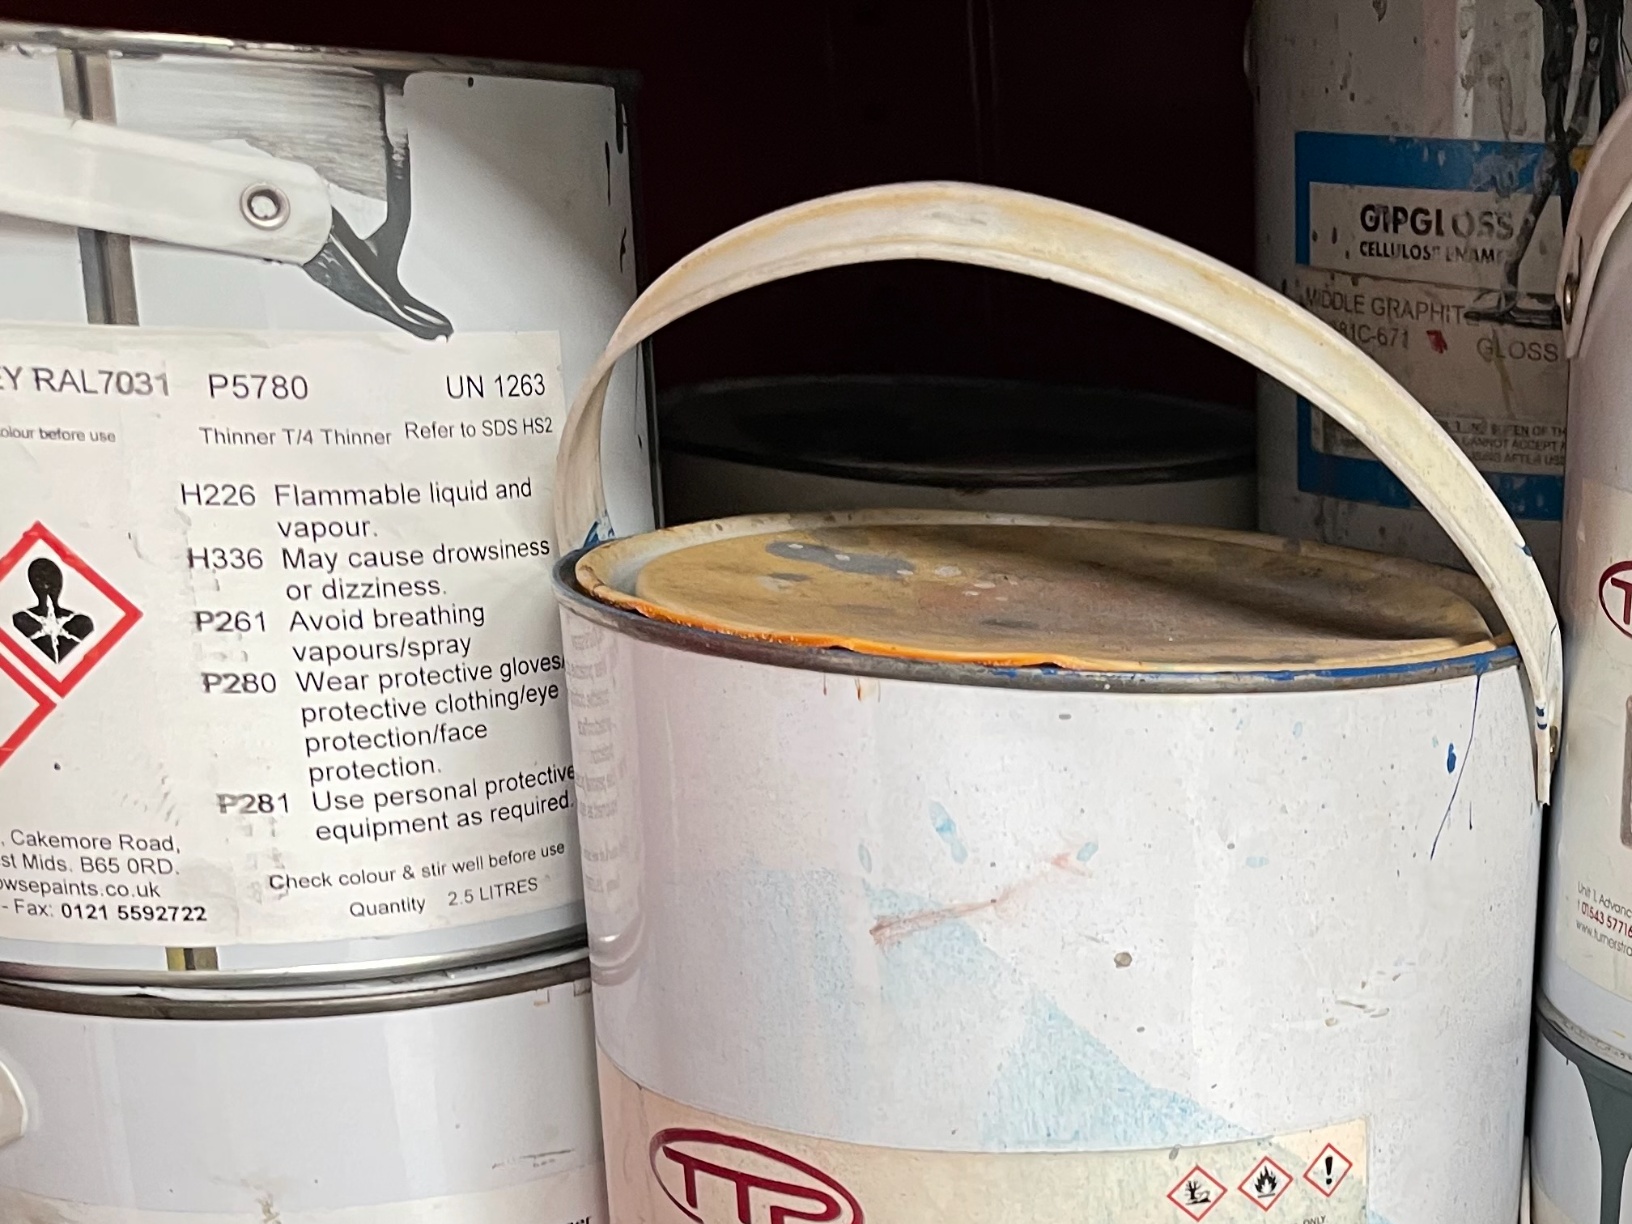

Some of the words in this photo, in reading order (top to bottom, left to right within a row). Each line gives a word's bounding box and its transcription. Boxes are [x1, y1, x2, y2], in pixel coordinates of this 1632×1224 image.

[1476, 337, 1559, 362] GLOSS
[34, 367, 170, 397] RAL7031
[208, 374, 308, 400] P5780
[447, 375, 484, 399] UN
[494, 373, 546, 398] 1263
[199, 427, 276, 446] Thinner
[320, 428, 392, 446] Thinner
[405, 421, 455, 440] Refer
[482, 419, 518, 437] SDS
[522, 417, 553, 435] HS2
[181, 483, 256, 506] H226
[275, 481, 422, 507] Flammable
[430, 481, 488, 507] liquid
[496, 477, 532, 500] and
[278, 520, 378, 542] vapour.
[187, 547, 264, 570] H336
[282, 548, 338, 574] May
[349, 548, 424, 569] cause
[433, 539, 550, 564] drowsiness
[322, 577, 447, 600] dizziness.
[194, 610, 267, 632] P261
[290, 608, 364, 632] Avoid
[373, 604, 485, 630] breathing
[292, 635, 471, 666] vapours/spray
[202, 672, 277, 694] P280
[295, 670, 368, 693] Wear
[379, 663, 493, 694] protective
[301, 697, 427, 727] protective
[435, 681, 560, 716] clothing/eye
[305, 722, 488, 757] protection/face
[309, 757, 442, 786] protection.
[312, 789, 365, 811] Use
[374, 777, 478, 812] personal
[485, 764, 575, 797] protective
[316, 815, 449, 844] equipment
[490, 790, 574, 822] required.
[10, 829, 112, 850] Cakemore
[119, 834, 180, 854] Road,
[80, 856, 120, 874] B65
[269, 874, 332, 890] Check
[339, 868, 397, 885] colour
[421, 863, 447, 877] stir
[452, 856, 484, 874] well
[489, 849, 536, 868] before
[541, 842, 565, 858] use
[14, 898, 54, 918] Fax:
[61, 903, 108, 920] 0121
[118, 905, 208, 922] 5592722
[349, 897, 426, 917] Quantity
[448, 889, 474, 906] 2.5
[479, 877, 538, 902] LITRES
